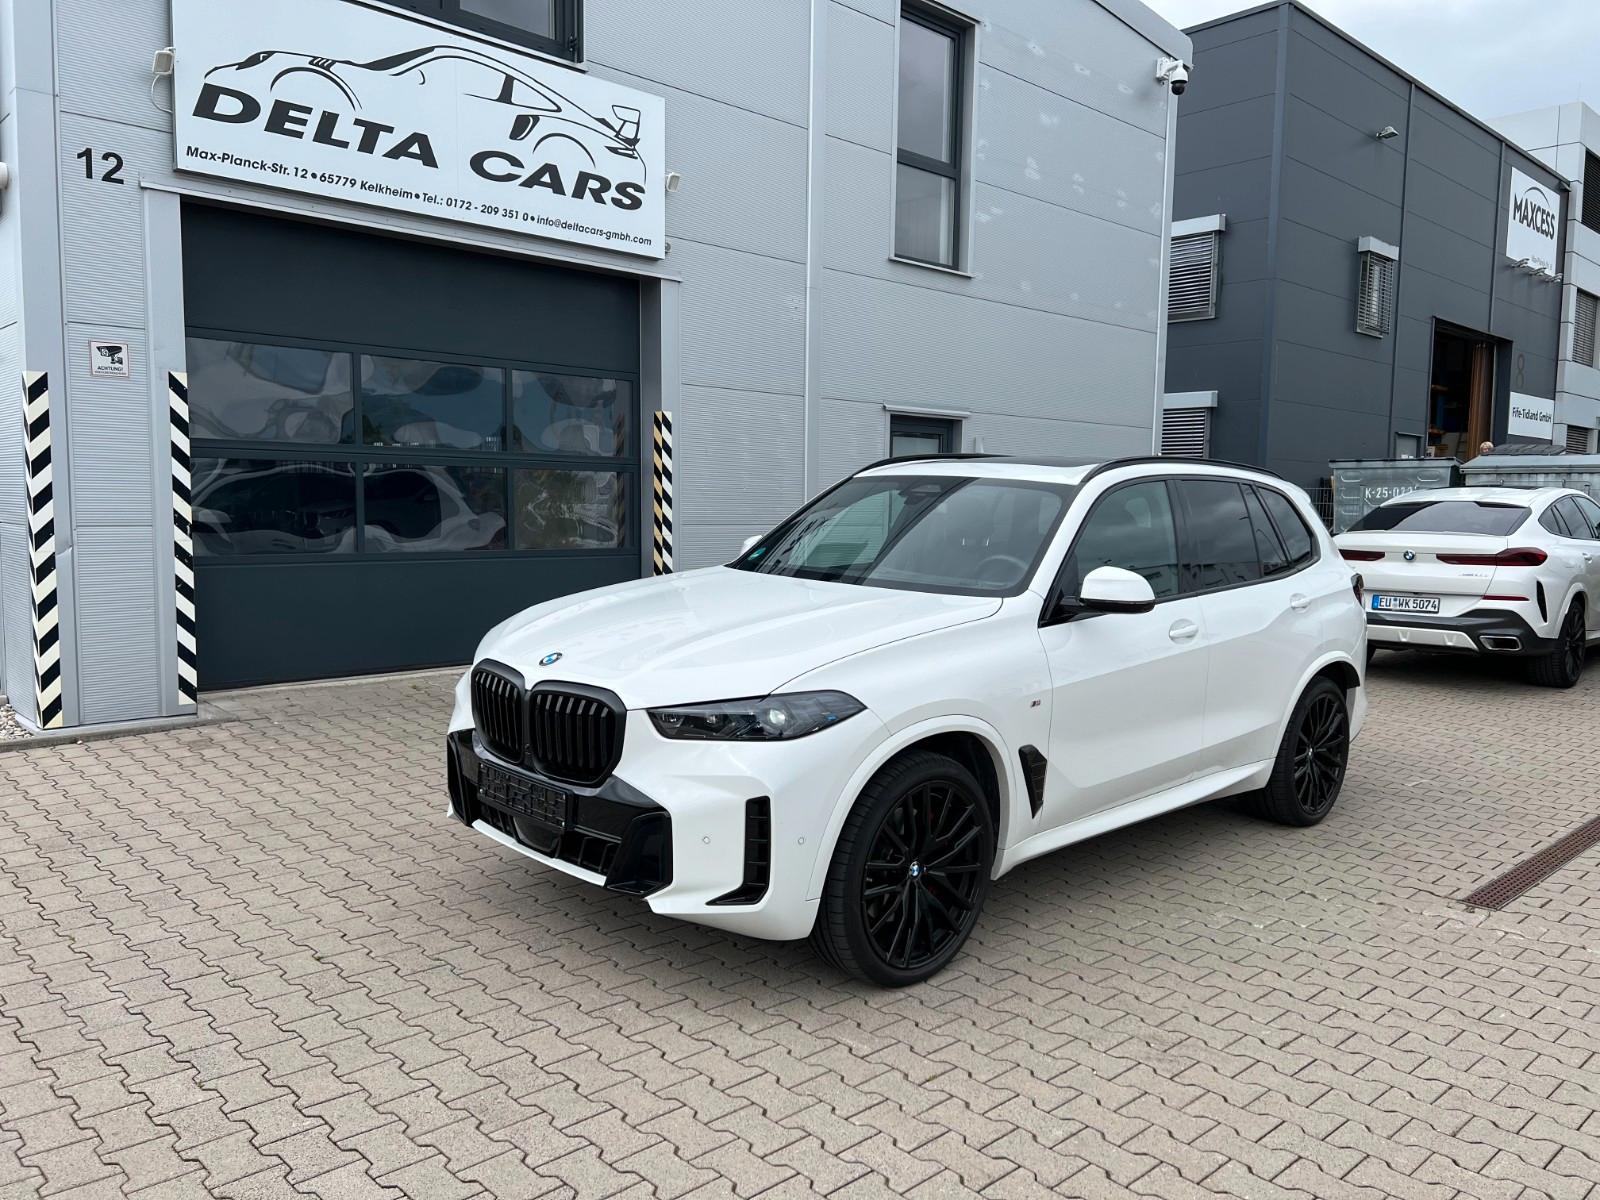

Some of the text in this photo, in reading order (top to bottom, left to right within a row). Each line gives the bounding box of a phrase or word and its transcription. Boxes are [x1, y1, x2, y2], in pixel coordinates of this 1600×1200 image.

[76, 147, 125, 185] 12
[192, 82, 646, 211] DELTA CARS
[186, 145, 290, 176] Max-Planck-Str.
[293, 166, 308, 179] 12
[319, 172, 357, 188] 65779
[359, 180, 413, 199] Kelkheim
[422, 192, 443, 206] Tel.:
[446, 197, 472, 211] 0172
[480, 204, 499, 216] 209
[501, 208, 519, 220] 351
[522, 212, 529, 222] 0
[536, 215, 652, 246] info@deltacars-gmbh.com
[1513, 193, 1556, 240] MAXCESS
[1539, 411, 1552, 423] GmbH
[1379, 597, 1437, 610] EU WK 5074
